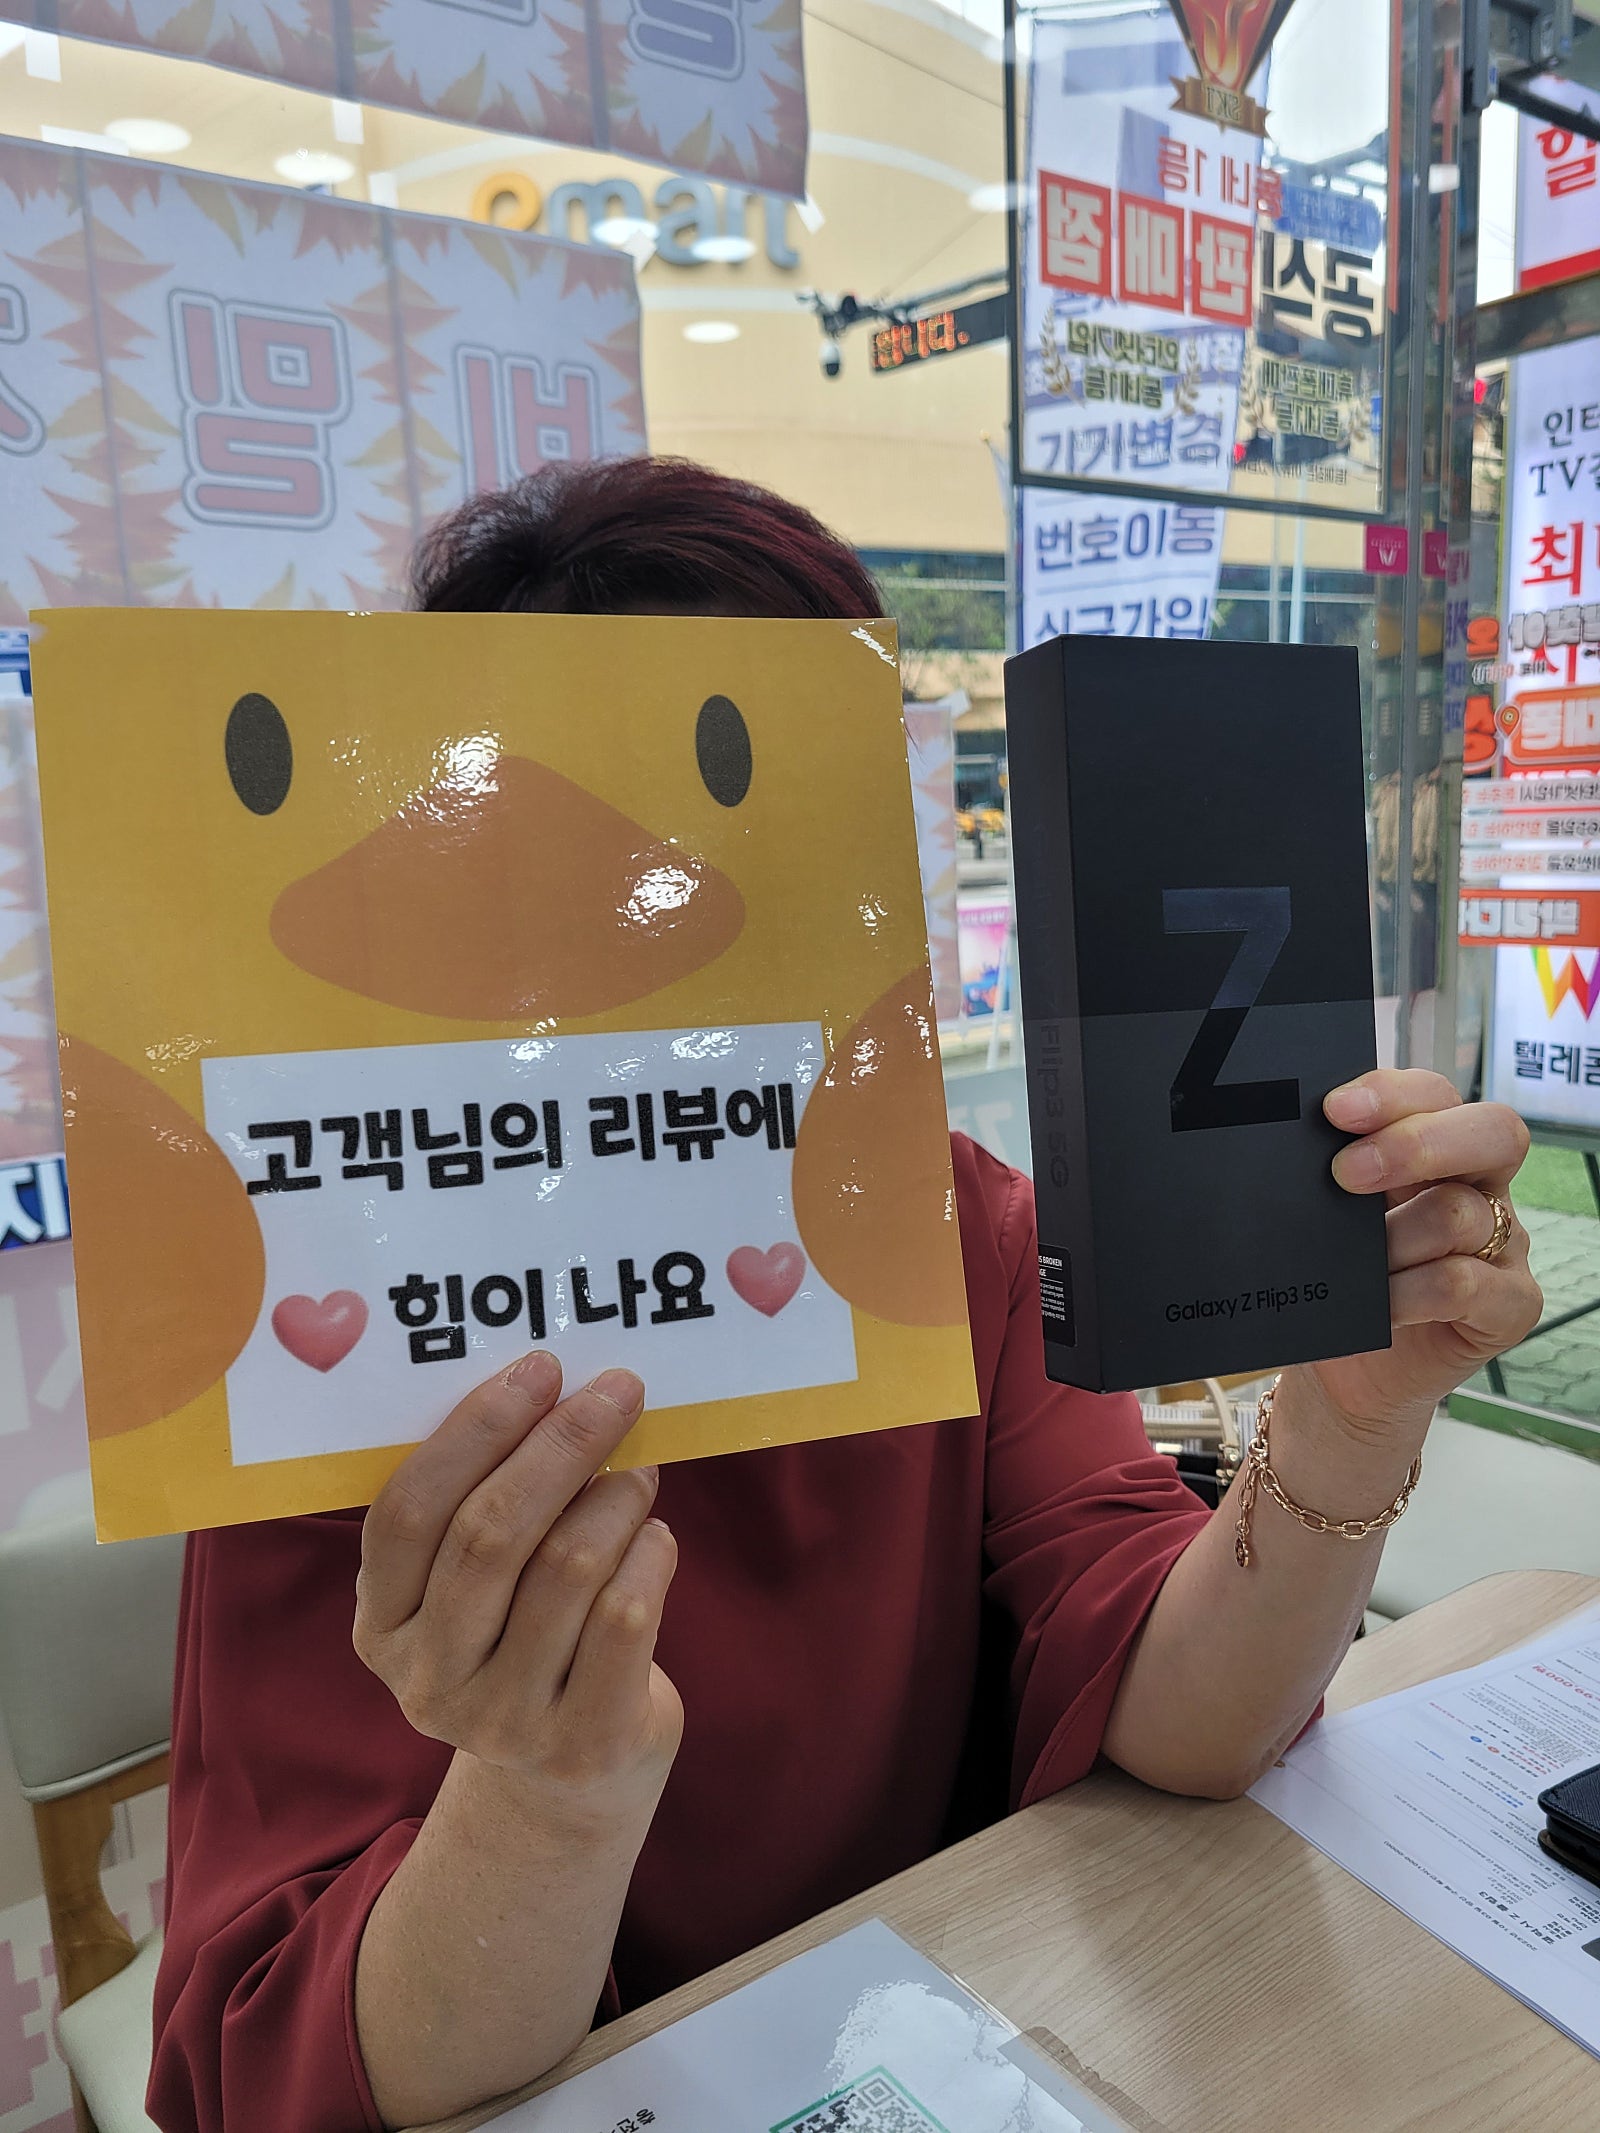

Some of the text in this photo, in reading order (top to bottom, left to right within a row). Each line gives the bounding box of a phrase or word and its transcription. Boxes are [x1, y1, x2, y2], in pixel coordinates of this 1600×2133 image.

[1036, 505, 1216, 572] 번호이동
[1161, 886, 1302, 1133] Z
[244, 1082, 798, 1196] 고객님의 리뷰에
[1043, 1256, 1063, 1268] BROKEN
[387, 1250, 716, 1364] 힘이 나요
[1165, 1282, 1329, 1323] Galaxy Z Flip3 5G
[1518, 1919, 1557, 1945] 갤럭시
[600, 2108, 656, 2133] 충전
